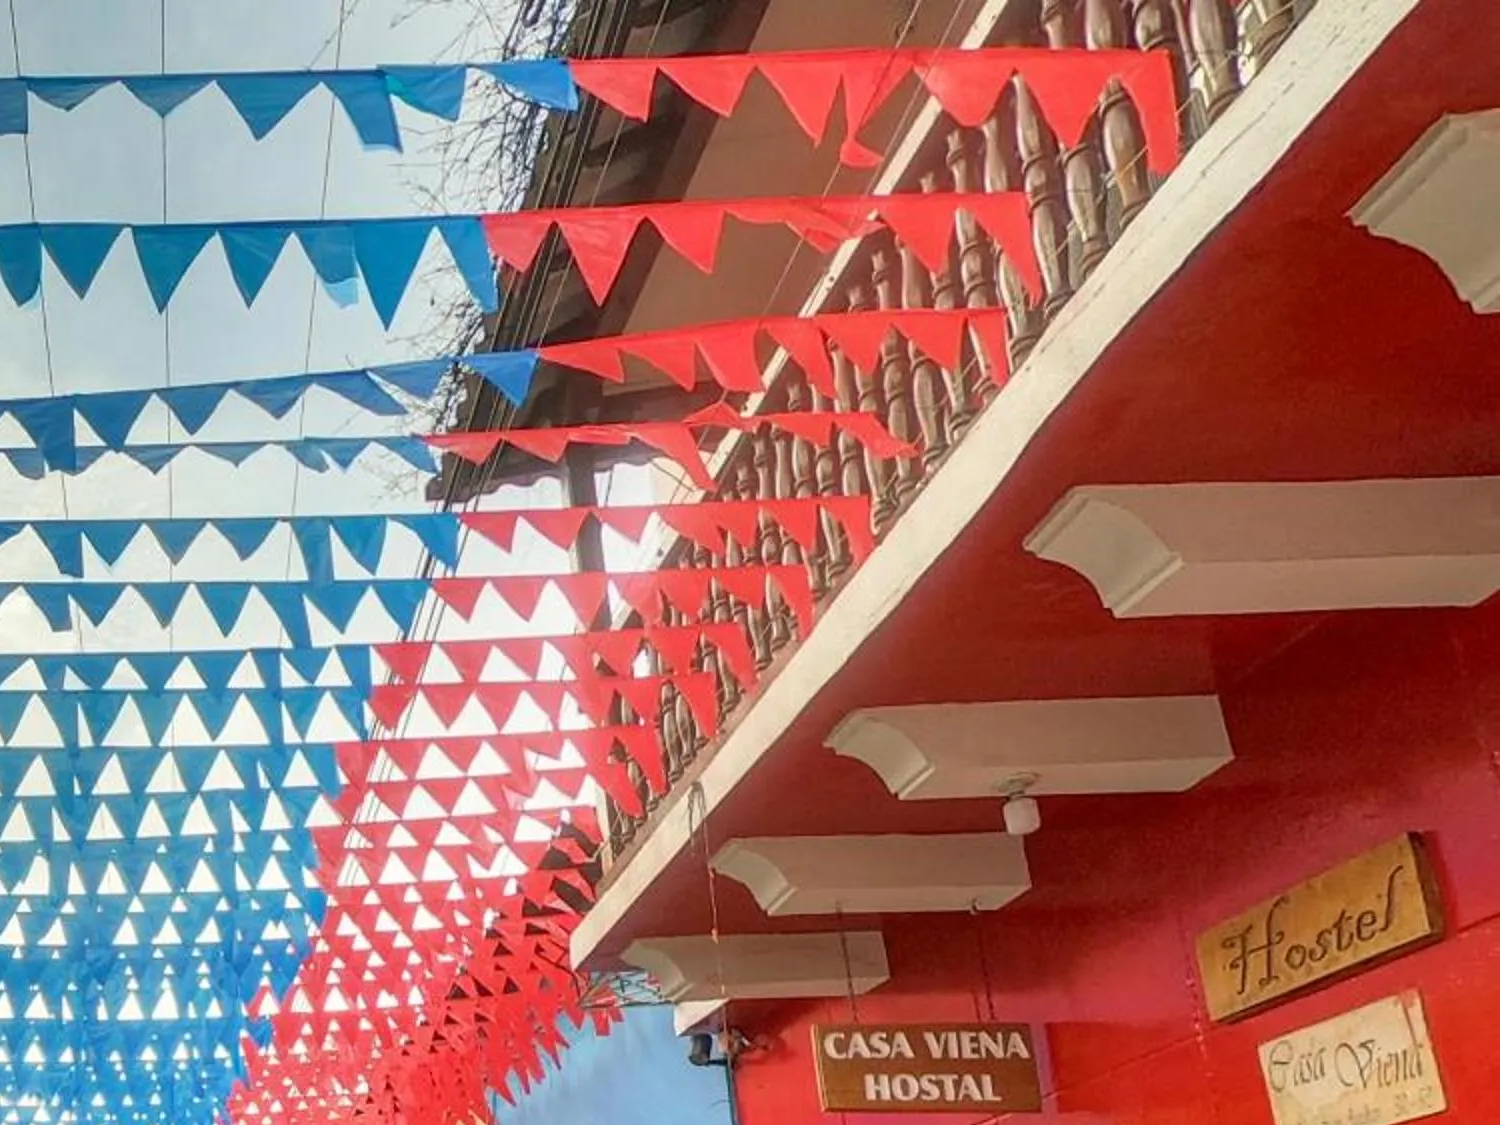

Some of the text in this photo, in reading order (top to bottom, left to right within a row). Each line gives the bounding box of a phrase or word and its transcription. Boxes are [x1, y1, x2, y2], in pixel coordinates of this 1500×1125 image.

[1222, 864, 1404, 995] Hostel
[823, 1031, 1031, 1060] CASA VIENA
[1269, 1038, 1424, 1093] Casa Viena
[864, 1073, 1002, 1102] HOSTAL
